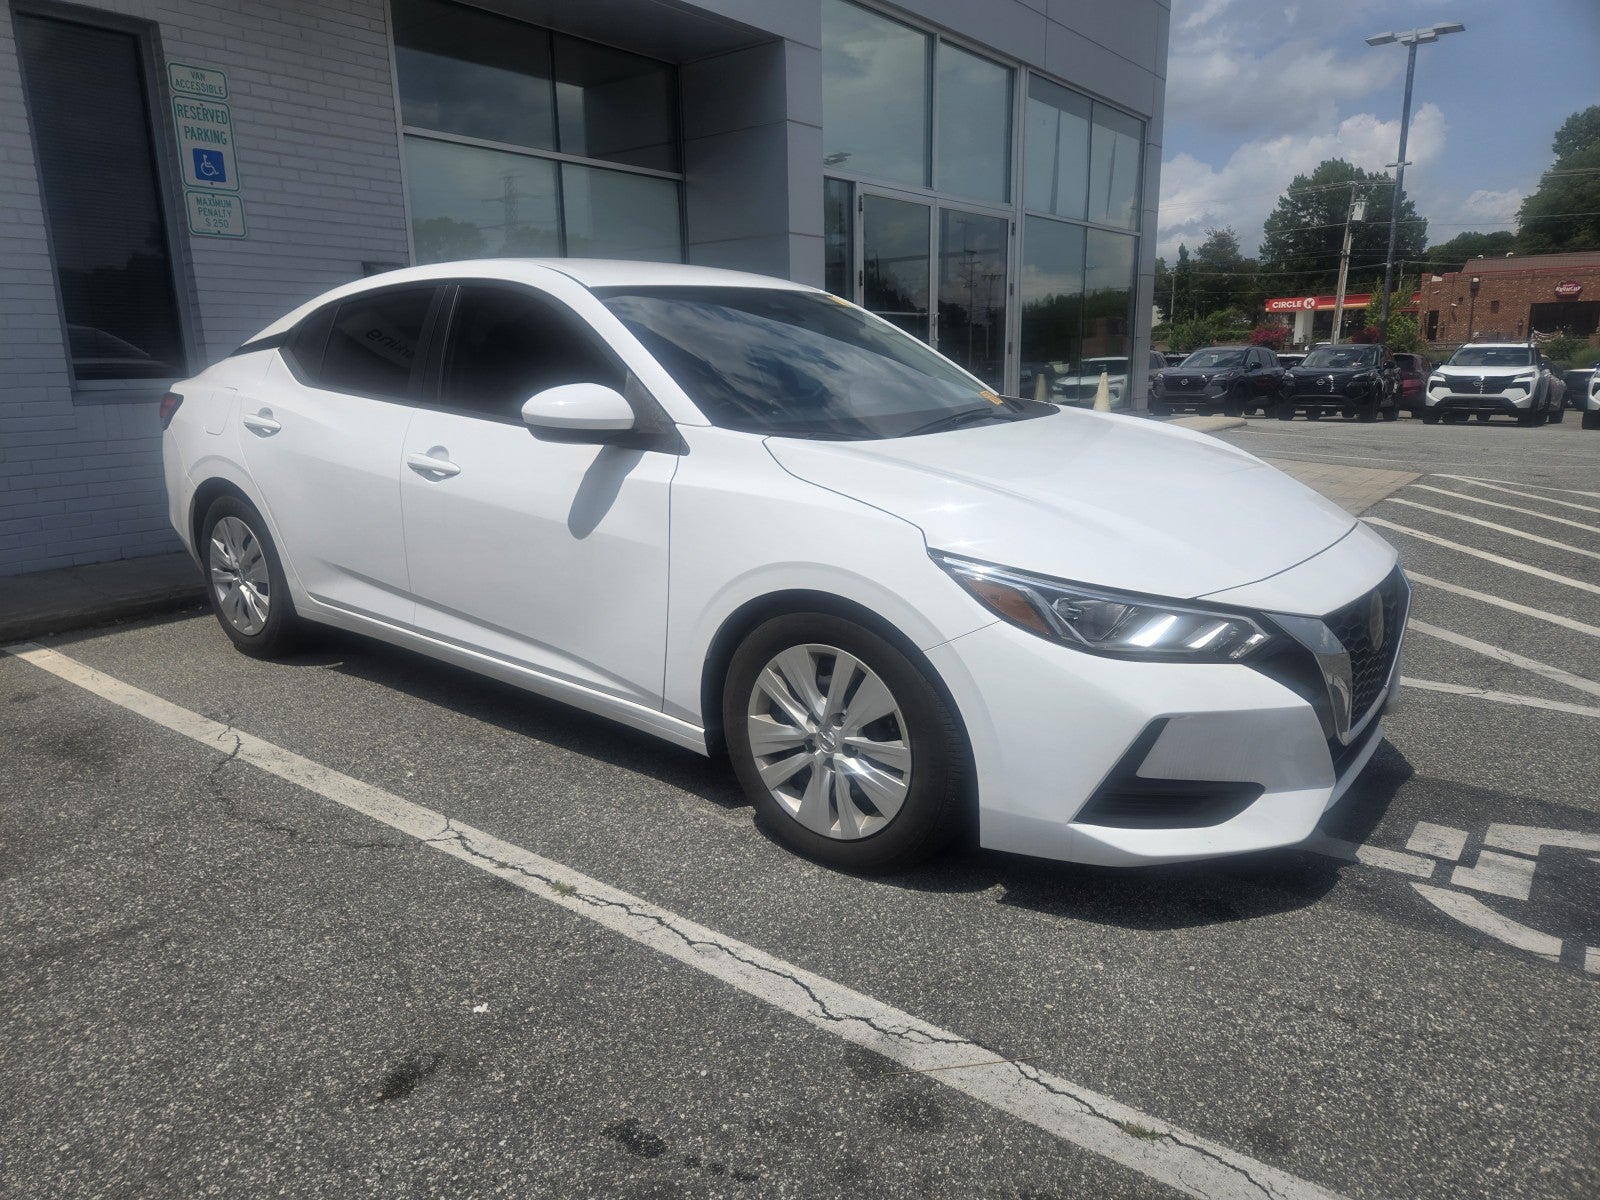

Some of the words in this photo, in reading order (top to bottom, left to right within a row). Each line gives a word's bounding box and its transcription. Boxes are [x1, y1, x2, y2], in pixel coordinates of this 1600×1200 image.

[191, 71, 206, 81] VAN
[175, 79, 223, 95] ACCESSIBLE
[177, 104, 228, 124] RESERVED
[184, 126, 227, 145] PARKING
[196, 196, 231, 208] MAXIMUM
[198, 207, 231, 218] PENALTY
[1272, 300, 1302, 309] CIRCLE
